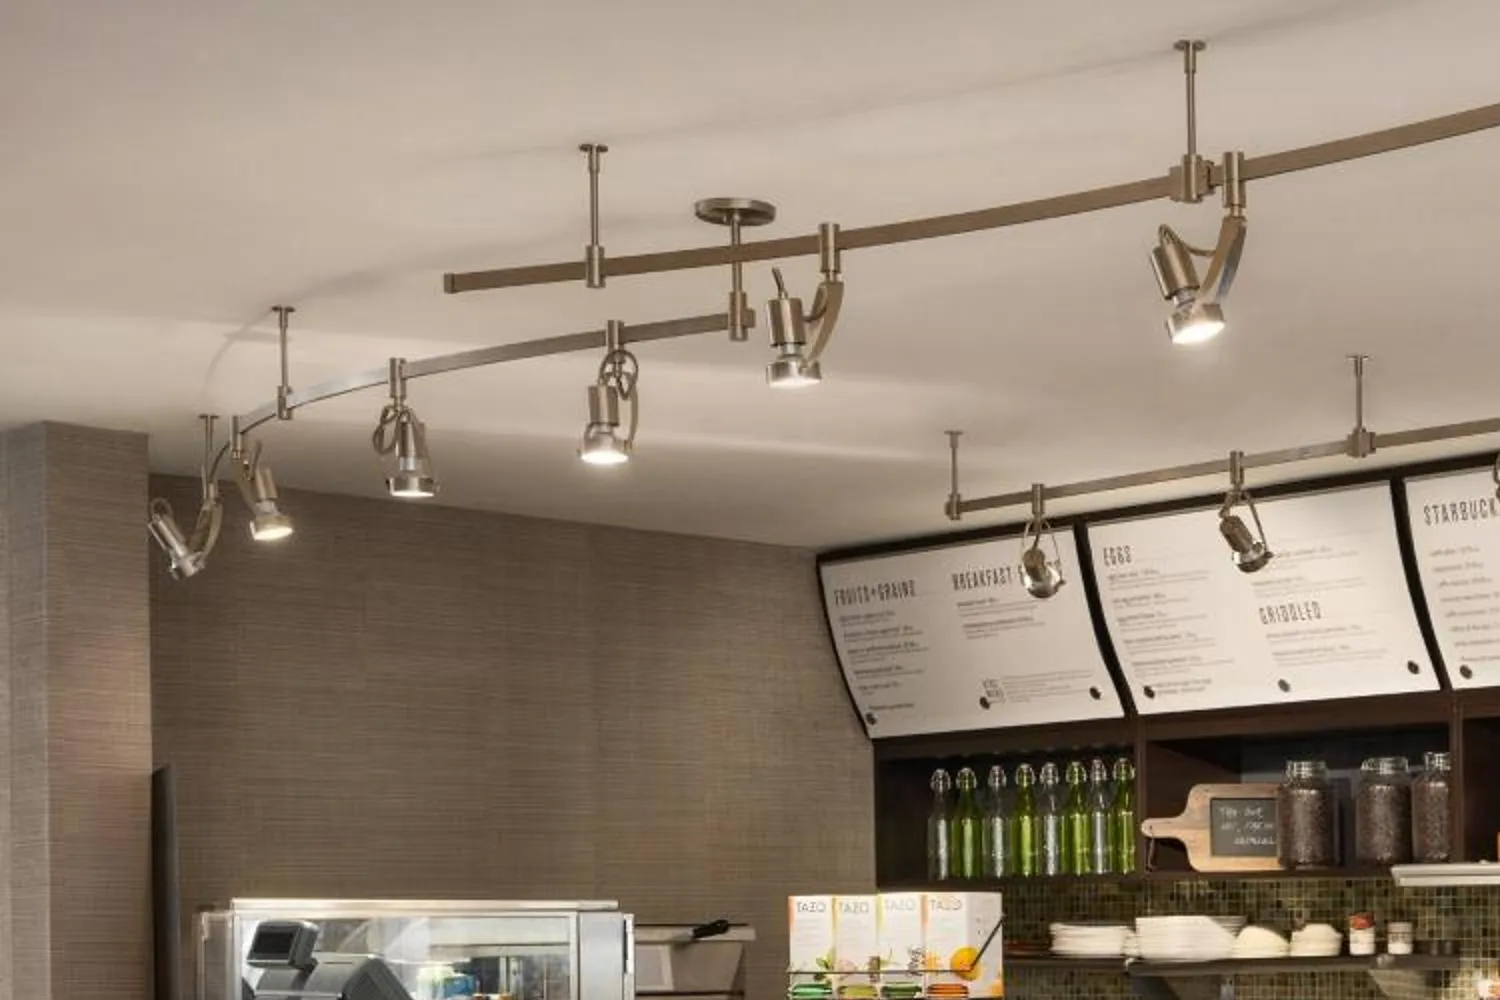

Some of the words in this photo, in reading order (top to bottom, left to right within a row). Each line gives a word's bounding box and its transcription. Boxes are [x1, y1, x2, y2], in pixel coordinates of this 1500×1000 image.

[1103, 545, 1133, 567] EGGS
[952, 565, 1013, 592] BREAKFAST
[1258, 601, 1322, 625] GRIDDLED
